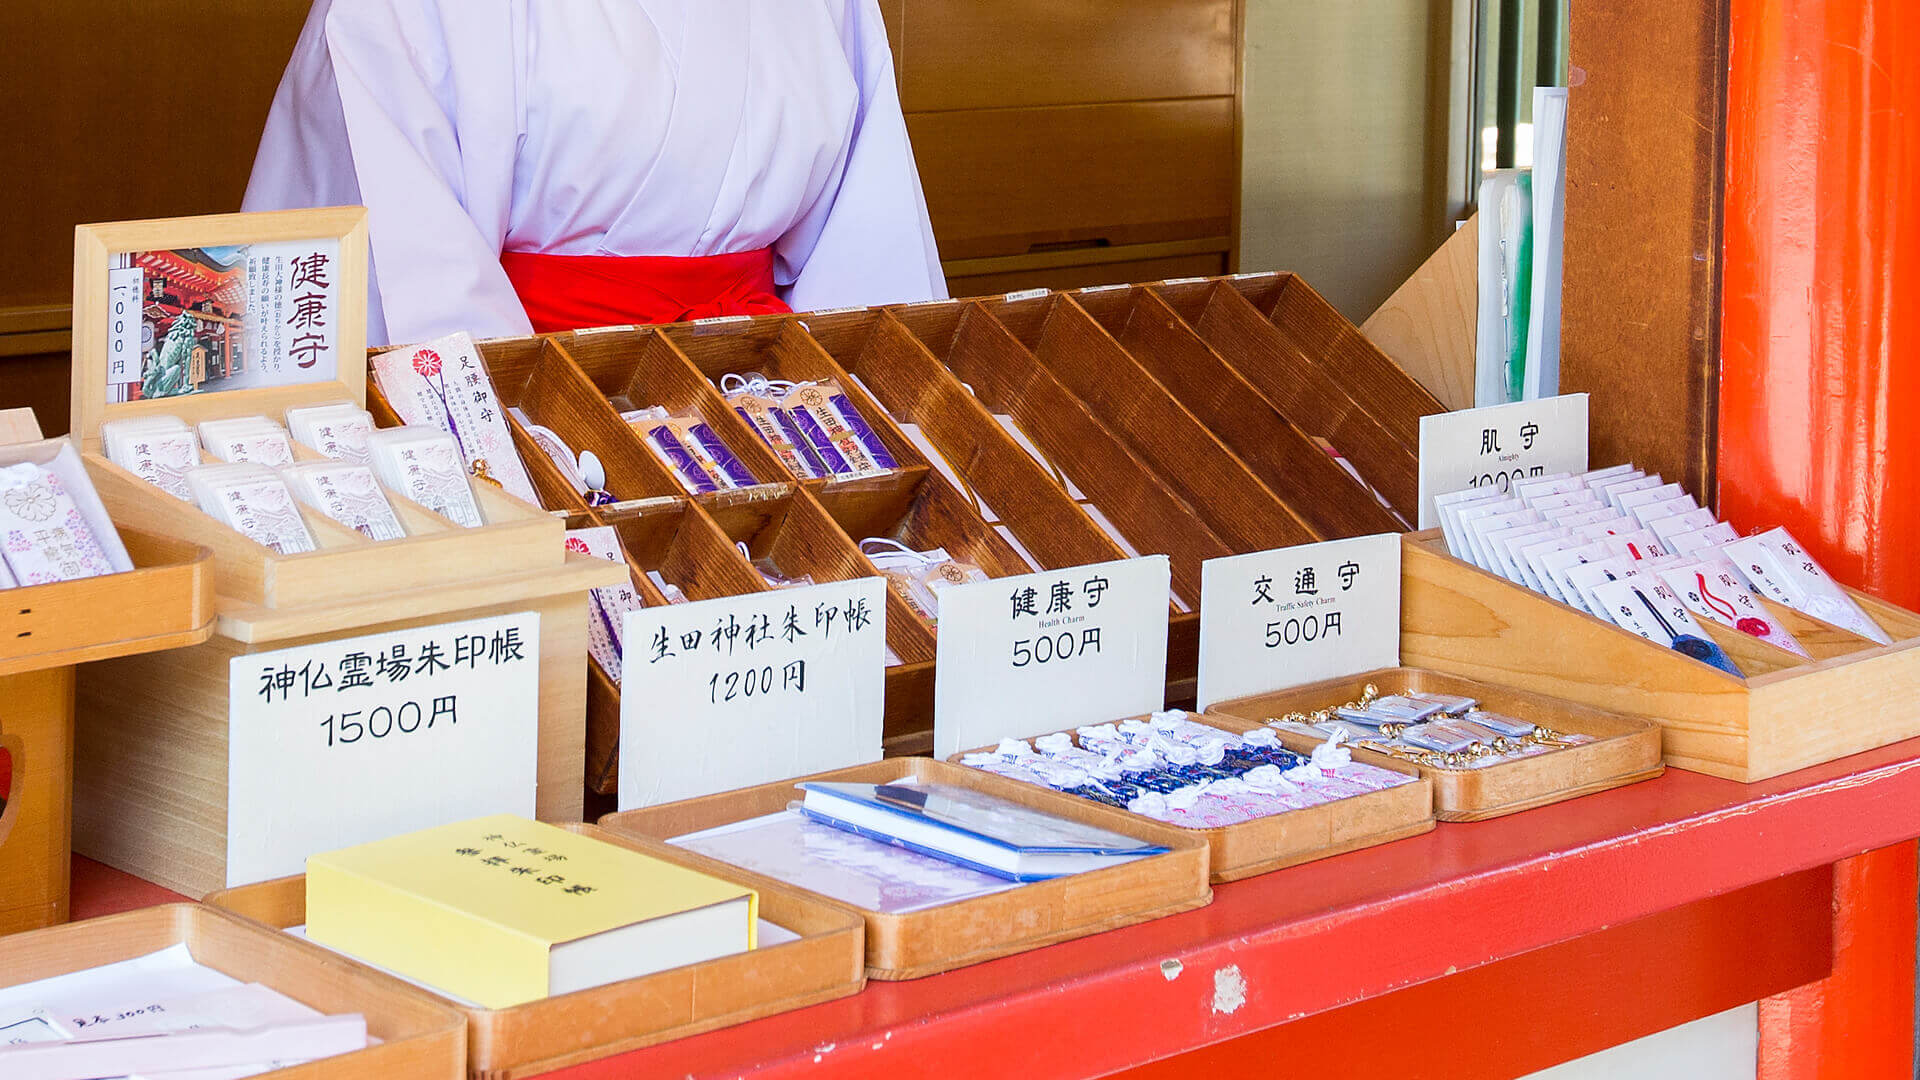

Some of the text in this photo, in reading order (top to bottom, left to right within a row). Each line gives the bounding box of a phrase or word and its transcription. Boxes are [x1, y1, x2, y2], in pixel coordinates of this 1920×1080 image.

[286, 252, 330, 369] 健康守
[1480, 421, 1539, 456] 肌守
[1009, 575, 1110, 620] 健康守
[1251, 559, 1361, 605] 交通守
[1276, 597, 1336, 612] Traffic Safety Charm
[649, 598, 873, 664] 生田神社朱印帳
[1038, 615, 1085, 628] Health Charm
[1264, 611, 1342, 648] 500円
[258, 627, 525, 703] 神仏霊場朱印帳
[1012, 627, 1102, 667] 500円
[709, 659, 806, 704] 1200円
[320, 695, 458, 747] 1500円
